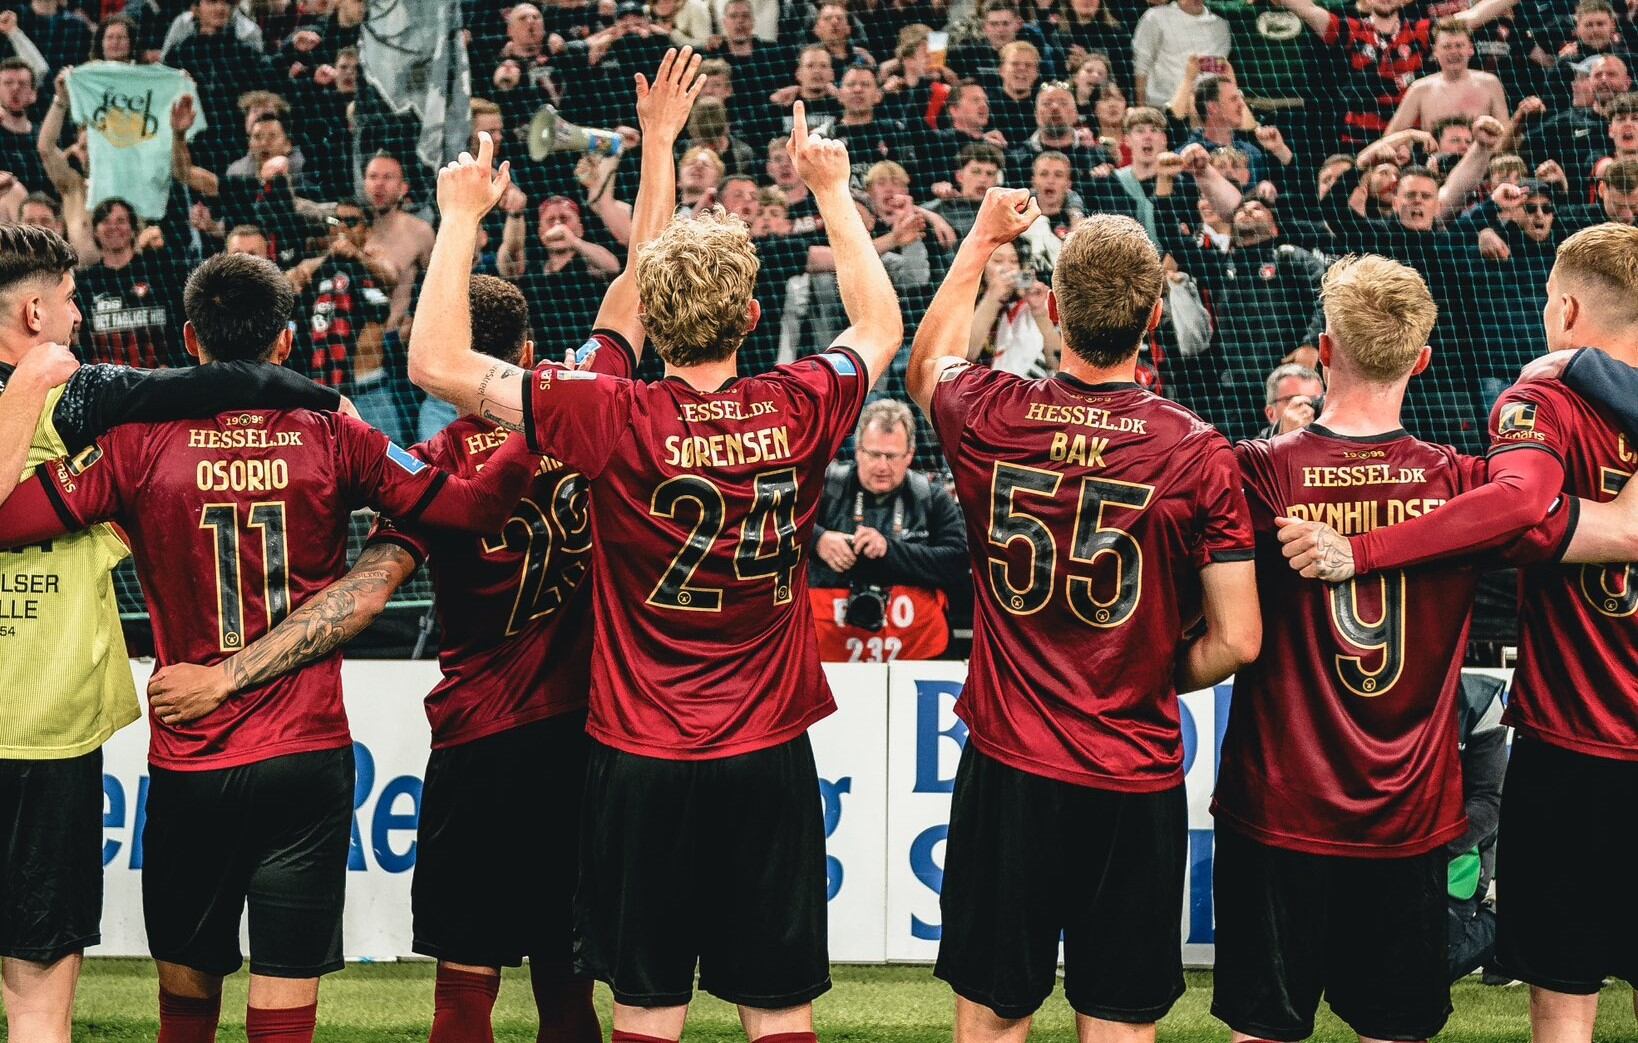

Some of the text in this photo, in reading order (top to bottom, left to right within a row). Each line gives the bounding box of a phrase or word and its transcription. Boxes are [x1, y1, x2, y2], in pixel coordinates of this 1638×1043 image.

[1025, 402, 1147, 435] HESSEL.DK
[188, 428, 304, 449] HESSEL.DK
[465, 426, 511, 455] HES
[664, 425, 792, 469] SØRENSEN
[1049, 431, 1110, 468] BAK
[196, 458, 289, 492] OSORIO
[1302, 464, 1427, 487] HESSEL.DK
[645, 467, 802, 612] 24
[988, 460, 1156, 629] 55
[1, 574, 59, 593] LSER
[199, 500, 291, 652] 11
